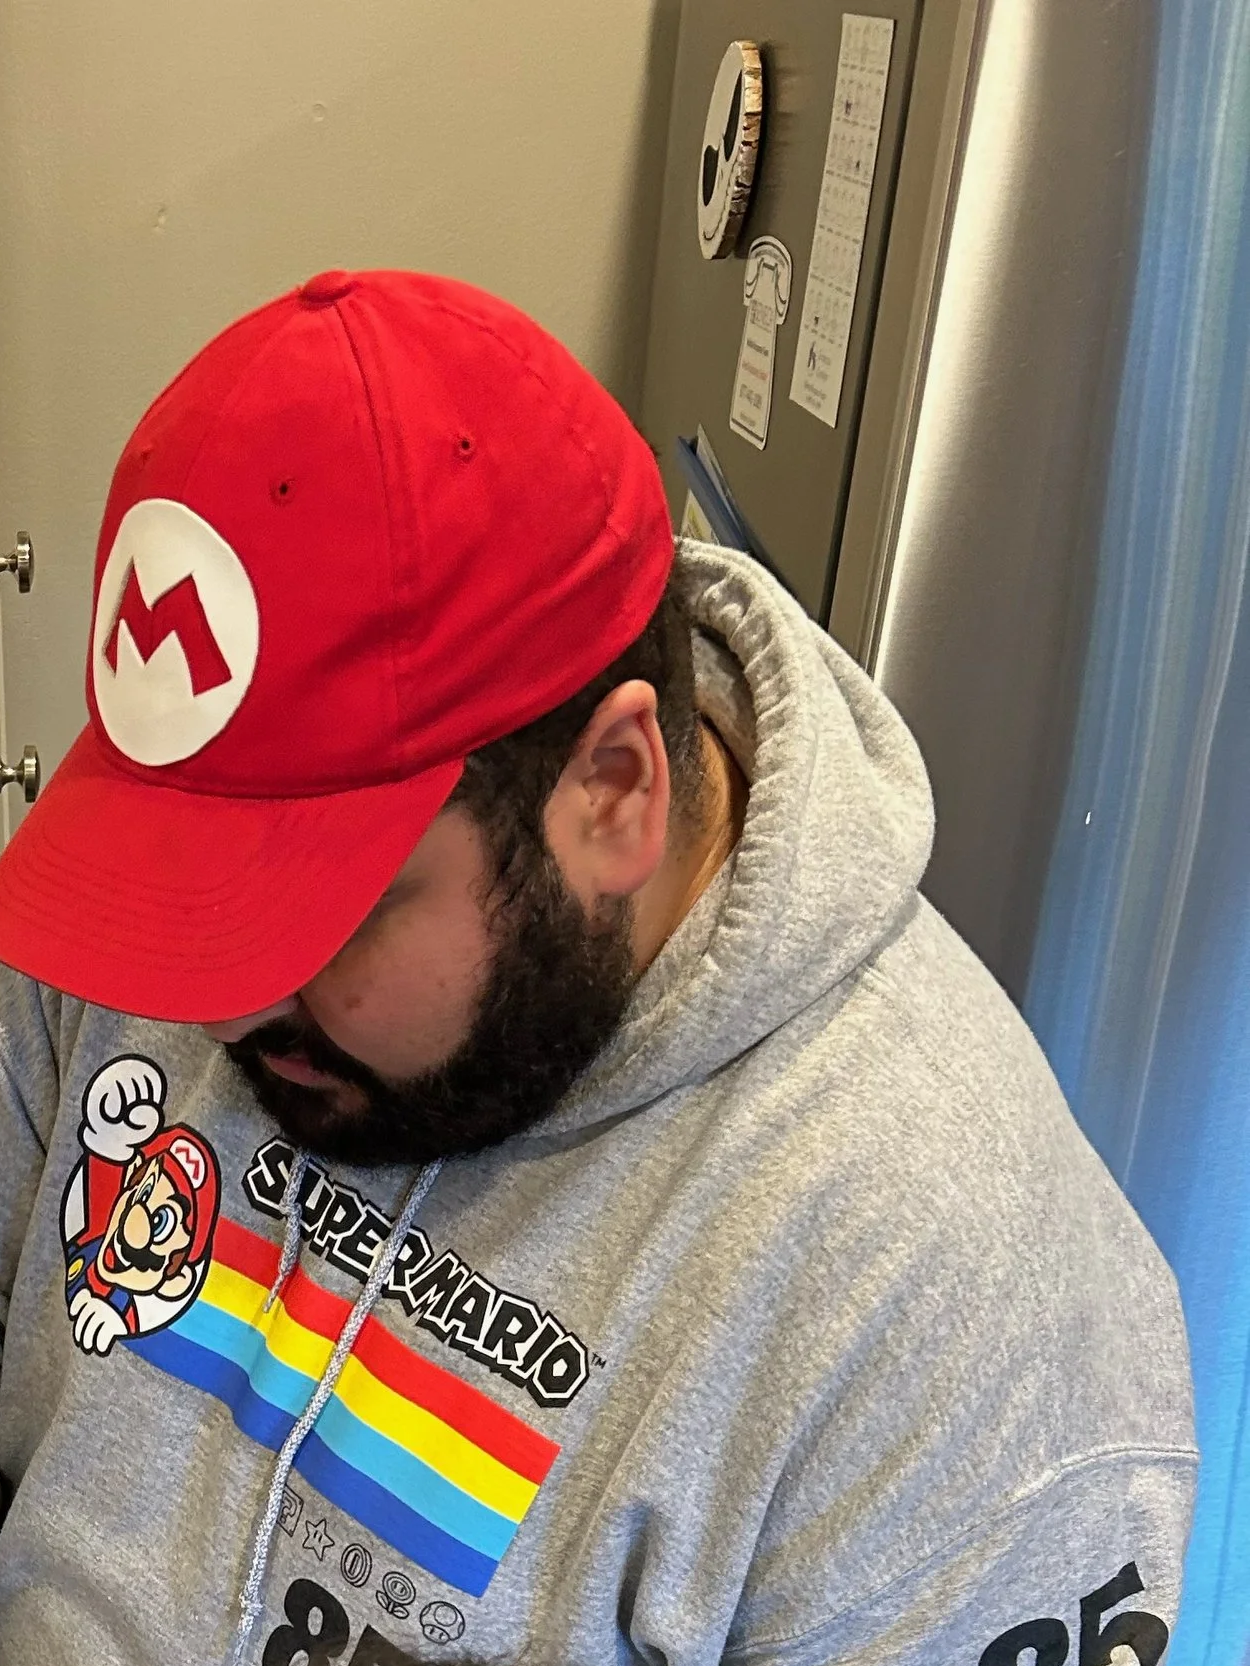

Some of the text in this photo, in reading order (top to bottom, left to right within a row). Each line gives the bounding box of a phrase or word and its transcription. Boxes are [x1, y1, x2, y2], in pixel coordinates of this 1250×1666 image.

[103, 557, 232, 697] M
[241, 1136, 434, 1299] SUPER
[402, 1248, 590, 1408] MARIO
